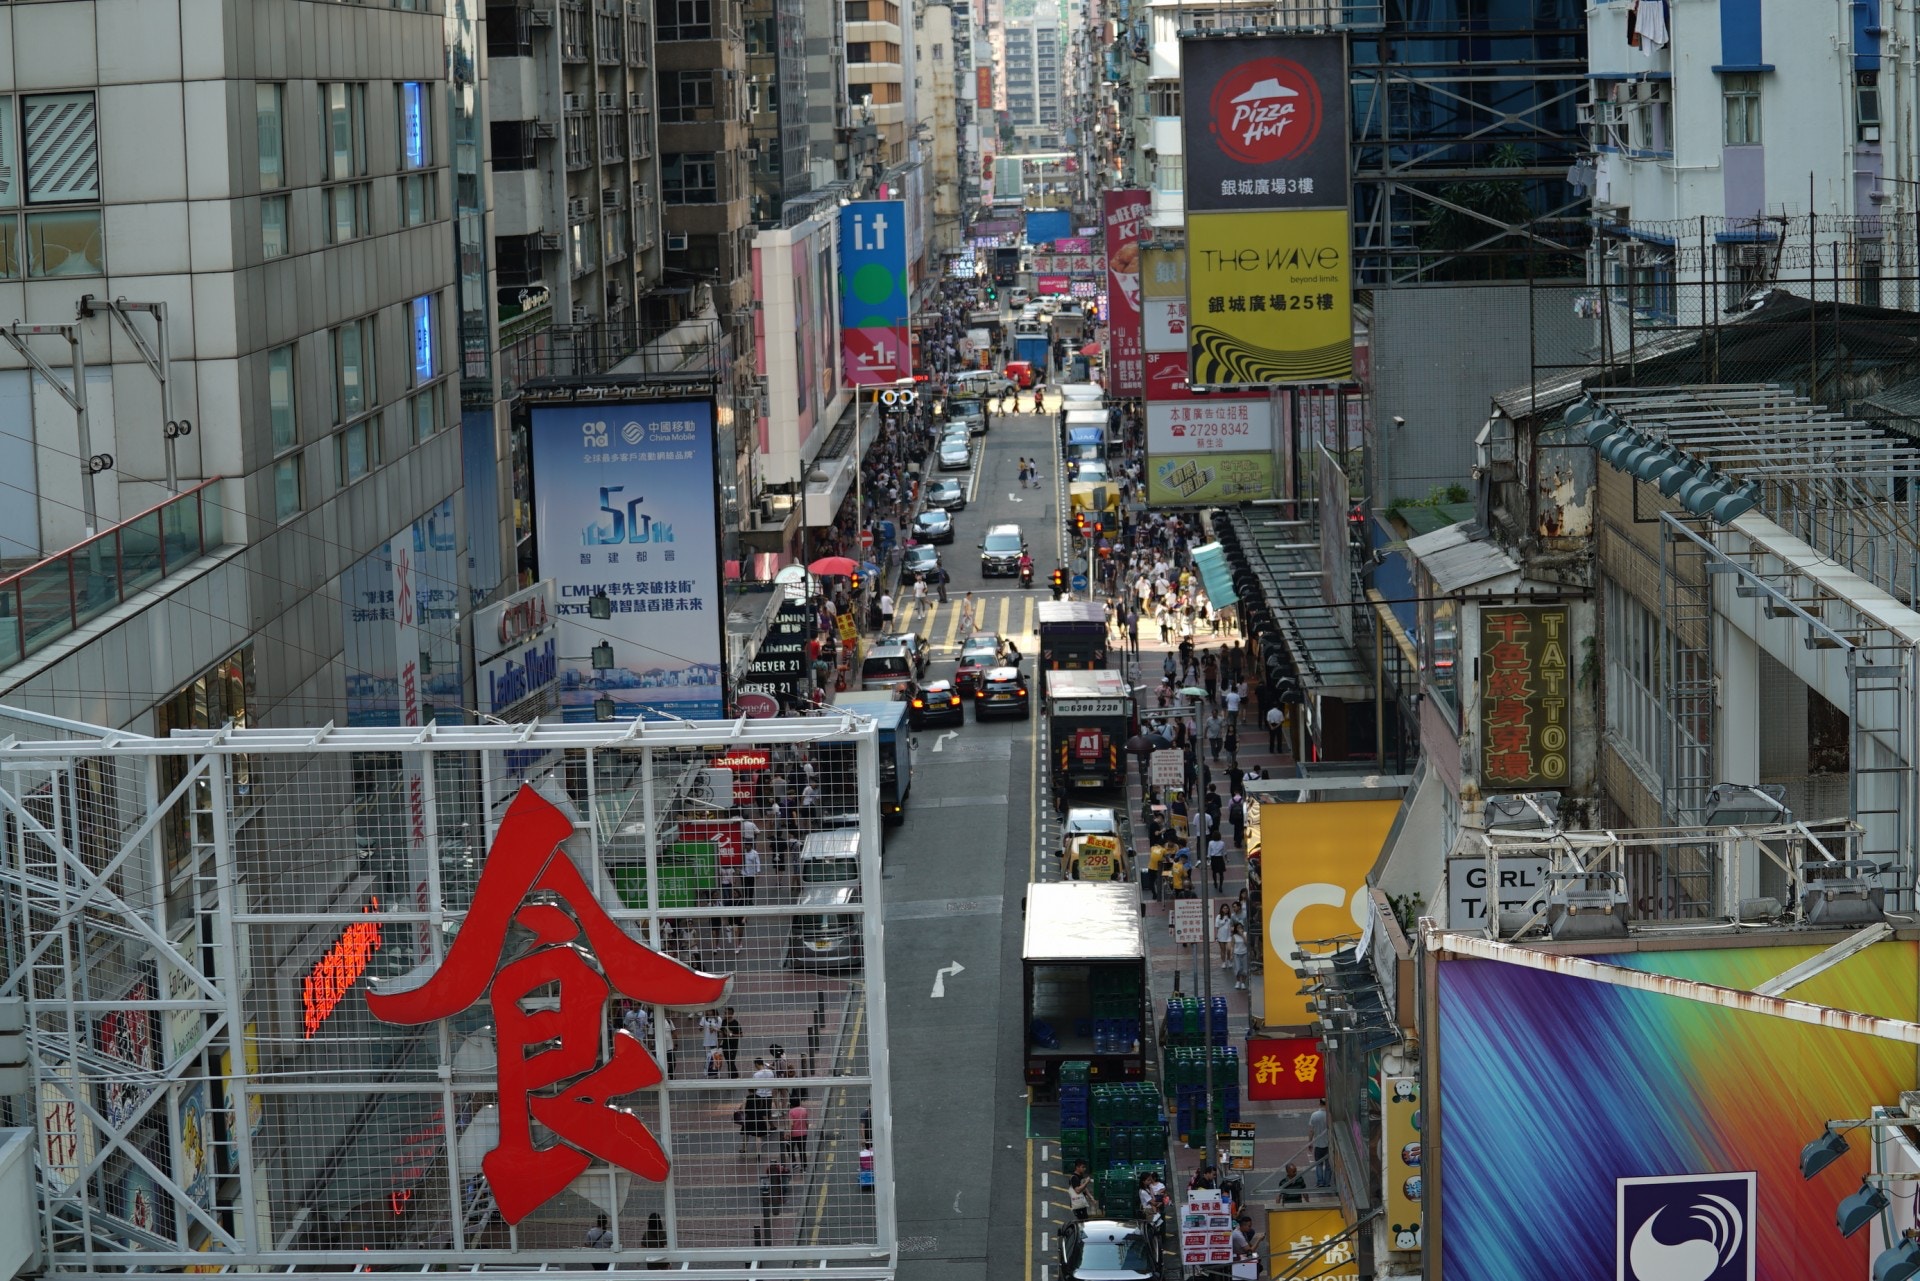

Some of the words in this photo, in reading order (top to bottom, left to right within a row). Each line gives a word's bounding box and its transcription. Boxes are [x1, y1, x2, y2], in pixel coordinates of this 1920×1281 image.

[1231, 99, 1295, 131] Pizza
[1243, 119, 1293, 146] Hut
[1221, 178, 1314, 196] 銀城廣場3樓
[854, 213, 888, 250] i.t
[1290, 276, 1318, 284] beyond
[1320, 275, 1338, 283] limits
[1208, 293, 1334, 313] 銀城廣場25樓
[873, 341, 896, 364] 1F
[1148, 354, 1160, 363] 3F
[648, 420, 696, 433] 中國移動
[1190, 423, 1218, 437] 2729
[1221, 423, 1249, 436] 8342
[650, 434, 671, 442] China
[671, 433, 696, 441] Mobile
[600, 485, 651, 545] 5G
[790, 660, 800, 670] 21
[489, 659, 526, 713] Ladies
[524, 638, 557, 692] World
[781, 683, 790, 693] 21
[1485, 612, 1537, 783] 千色紋身穿環
[1540, 612, 1567, 780] TATTOO
[1071, 704, 1093, 712] 6390
[1096, 704, 1118, 712] 2230
[1079, 734, 1099, 750] A1
[366, 783, 727, 1225] 食
